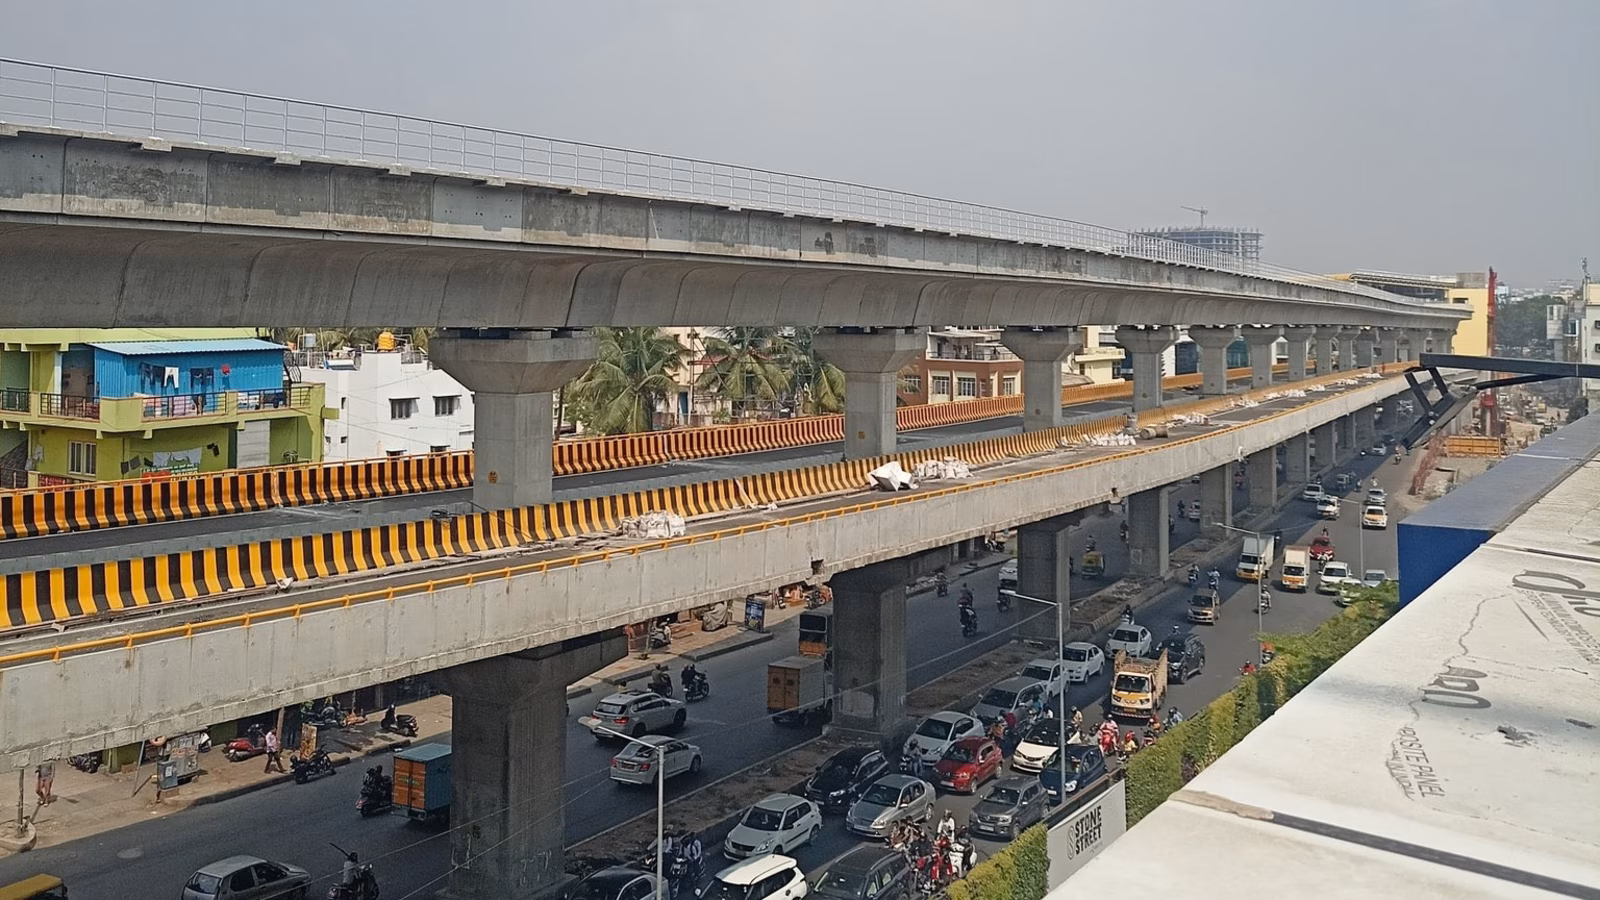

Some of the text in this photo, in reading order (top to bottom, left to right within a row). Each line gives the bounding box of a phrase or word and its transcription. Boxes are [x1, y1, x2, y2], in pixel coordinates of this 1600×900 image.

[1400, 727, 1429, 763] POSITE
[1409, 764, 1445, 797] PANEL
[1075, 805, 1102, 838] STONE
[1075, 823, 1102, 855] STREET
